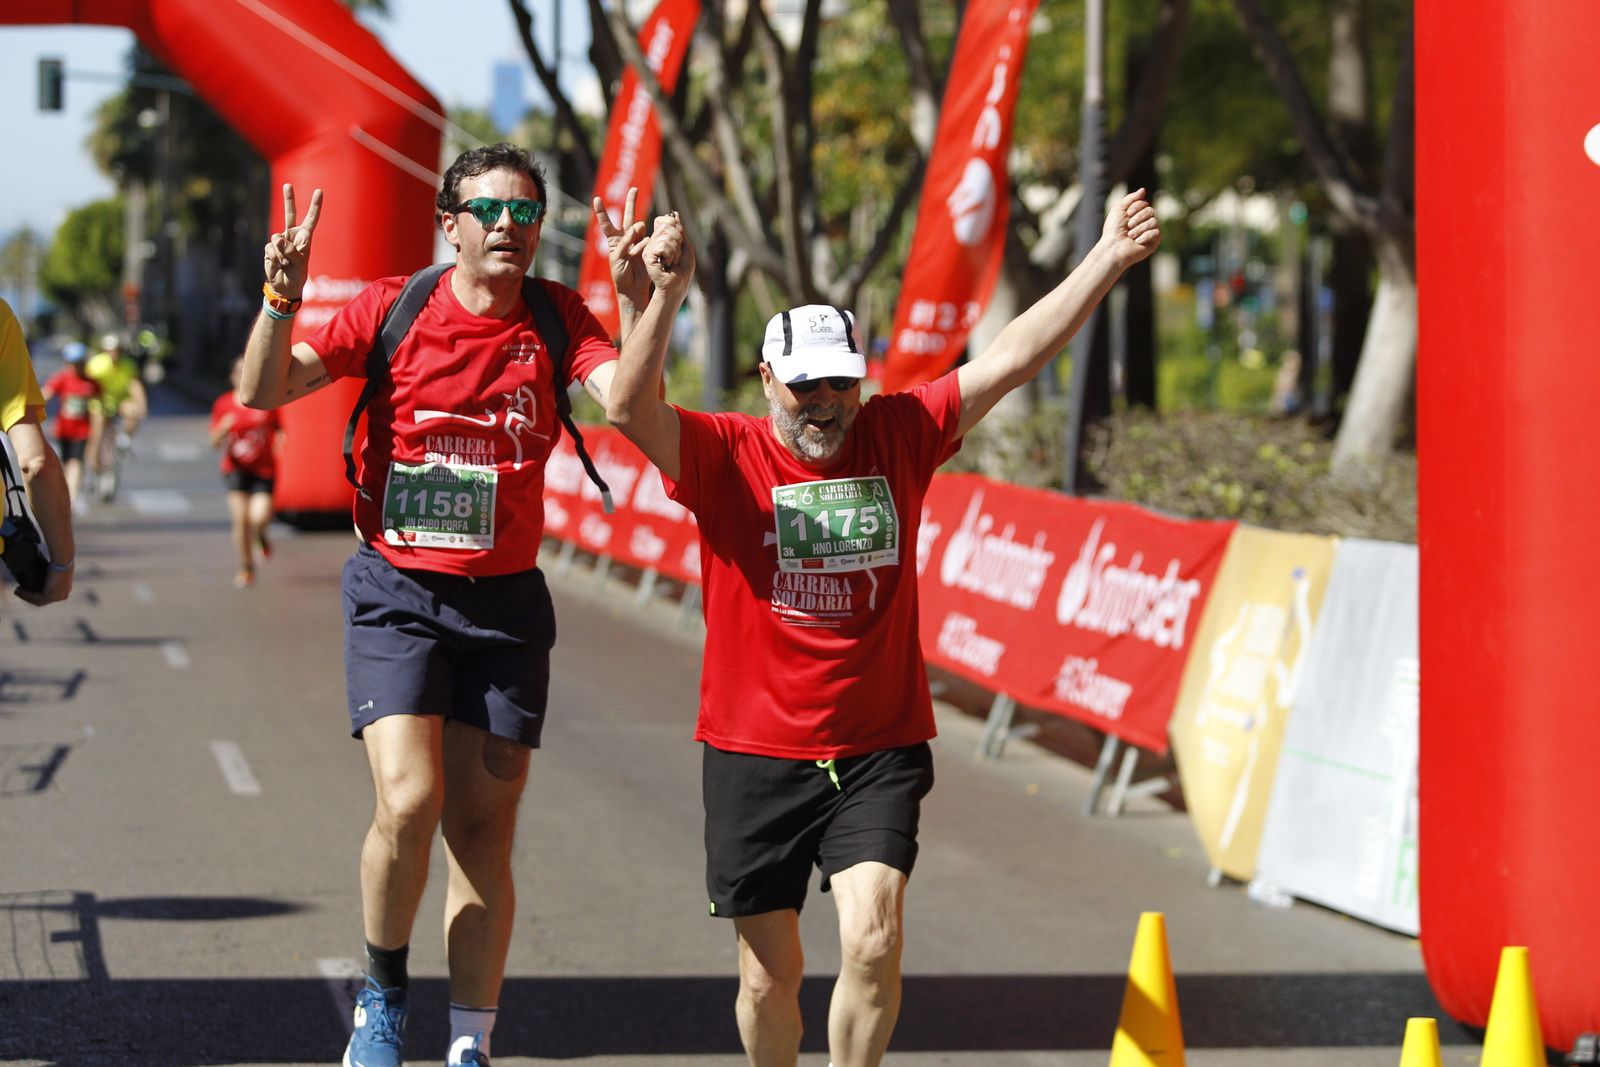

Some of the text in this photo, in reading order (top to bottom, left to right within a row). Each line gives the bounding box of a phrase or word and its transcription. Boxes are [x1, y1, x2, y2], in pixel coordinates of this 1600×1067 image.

[425, 435, 496, 454] CARRERA
[395, 488, 473, 518] 1158
[801, 486, 814, 505] 6
[819, 483, 861, 494] CARRERA
[819, 491, 863, 502] SOLIDARIA
[404, 516, 416, 529] UN
[417, 518, 440, 530] CUBO
[441, 519, 468, 531] PORFA
[790, 505, 880, 541] 1175
[783, 537, 873, 557] 3k HNO LORENZO
[772, 570, 853, 595] CARRERA
[771, 589, 852, 611] SOLIDARIA
